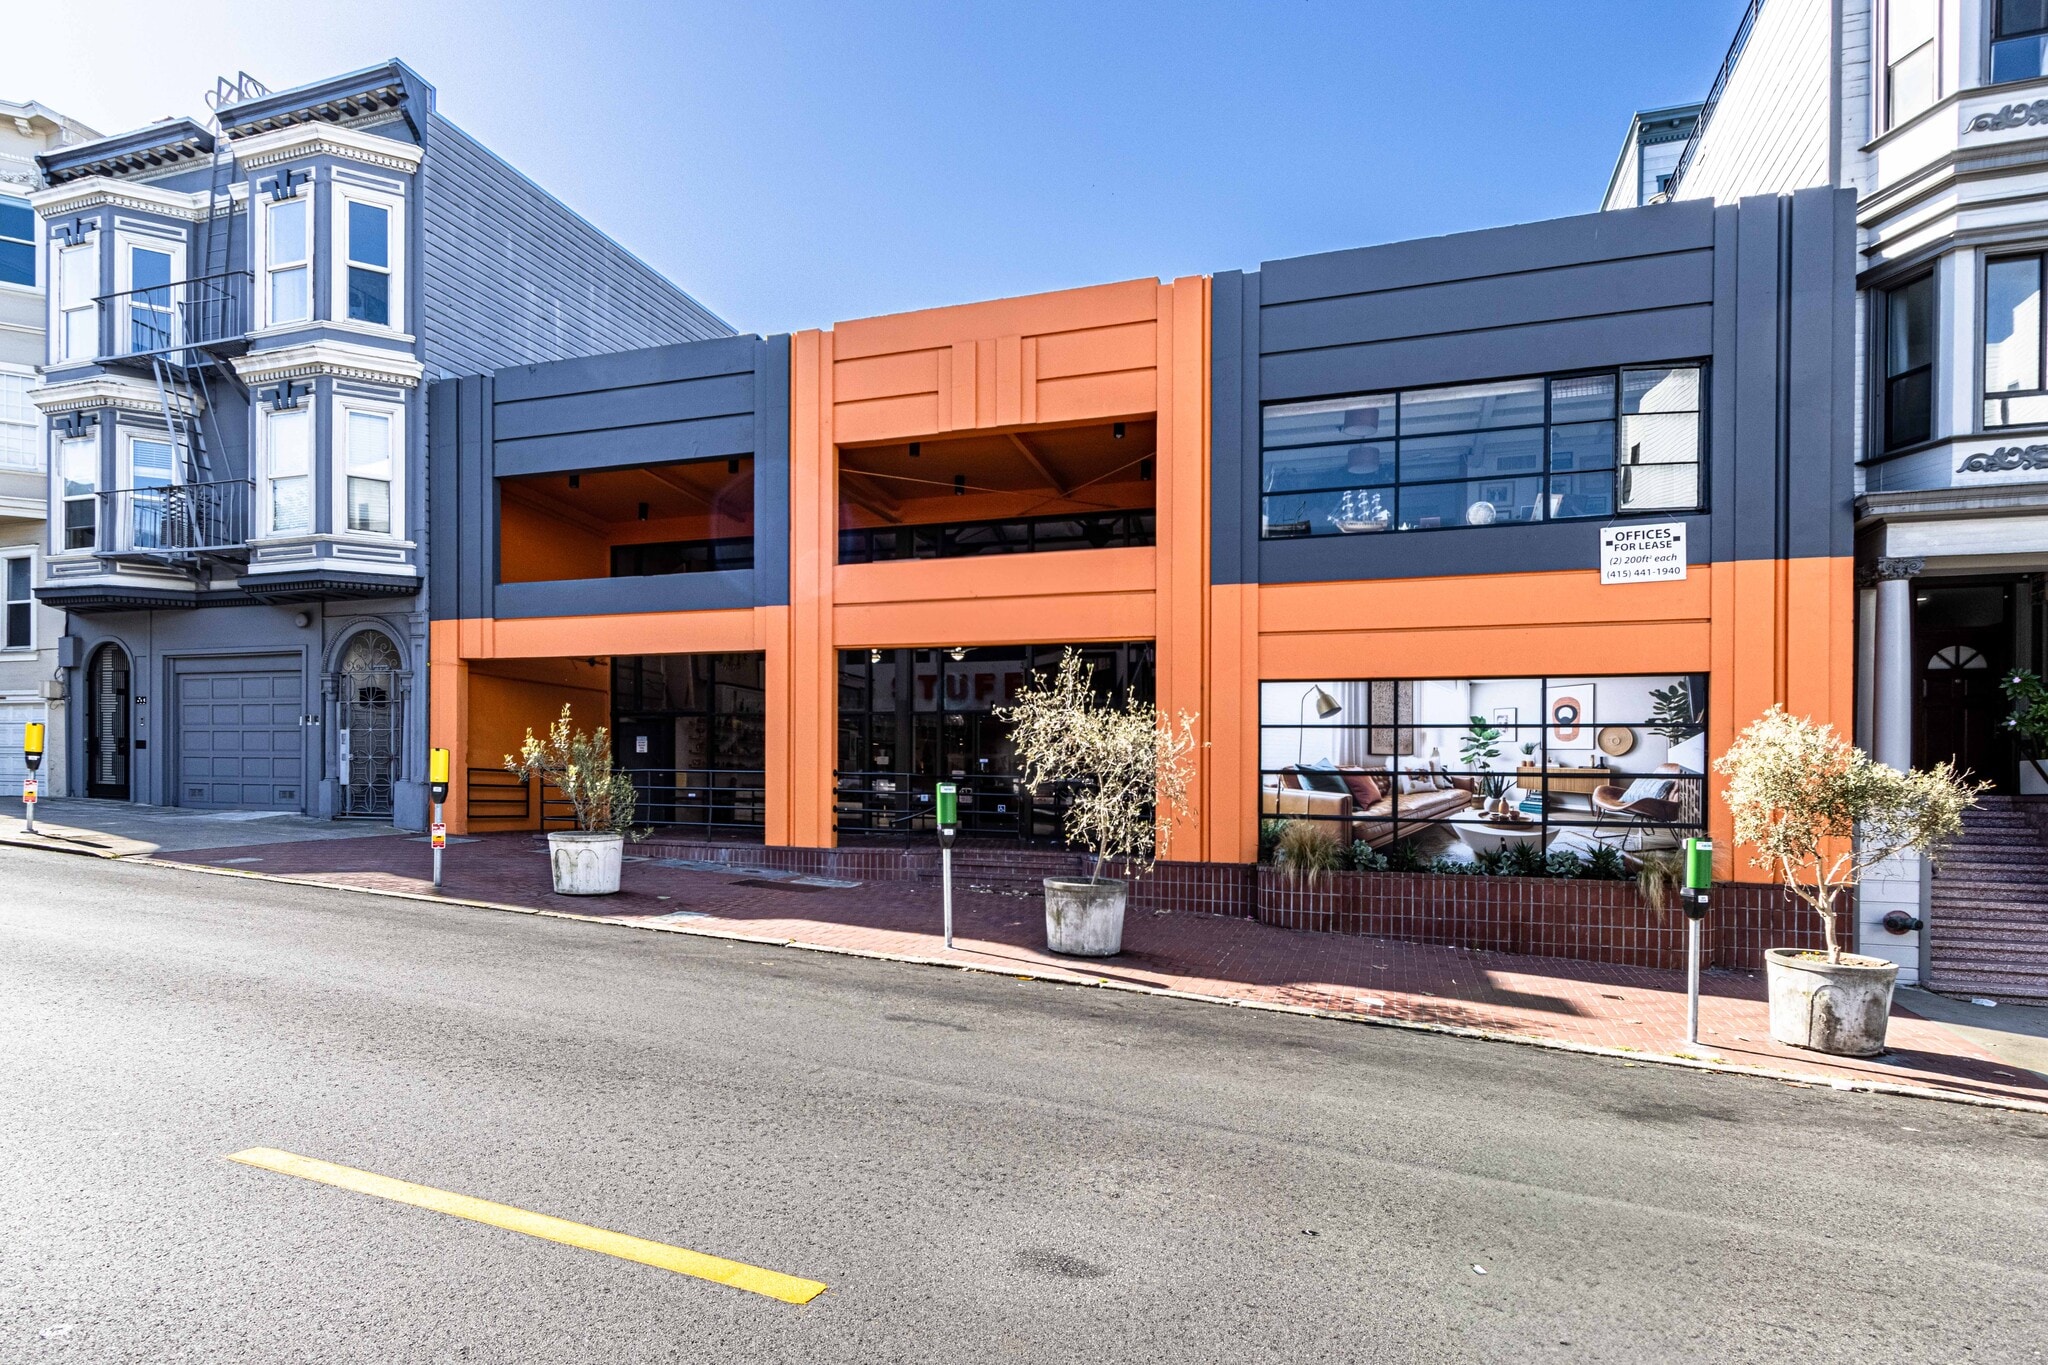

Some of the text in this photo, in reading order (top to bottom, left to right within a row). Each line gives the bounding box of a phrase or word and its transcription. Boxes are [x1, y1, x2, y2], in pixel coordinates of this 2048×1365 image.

[1615, 528, 1671, 542] OFFICES
[1614, 540, 1673, 552] FOR LEASE
[1609, 557, 1622, 566] (2)
[1654, 553, 1677, 562] each
[1607, 566, 1681, 579] (415) 441-1940
[892, 672, 1024, 701] TUFF
